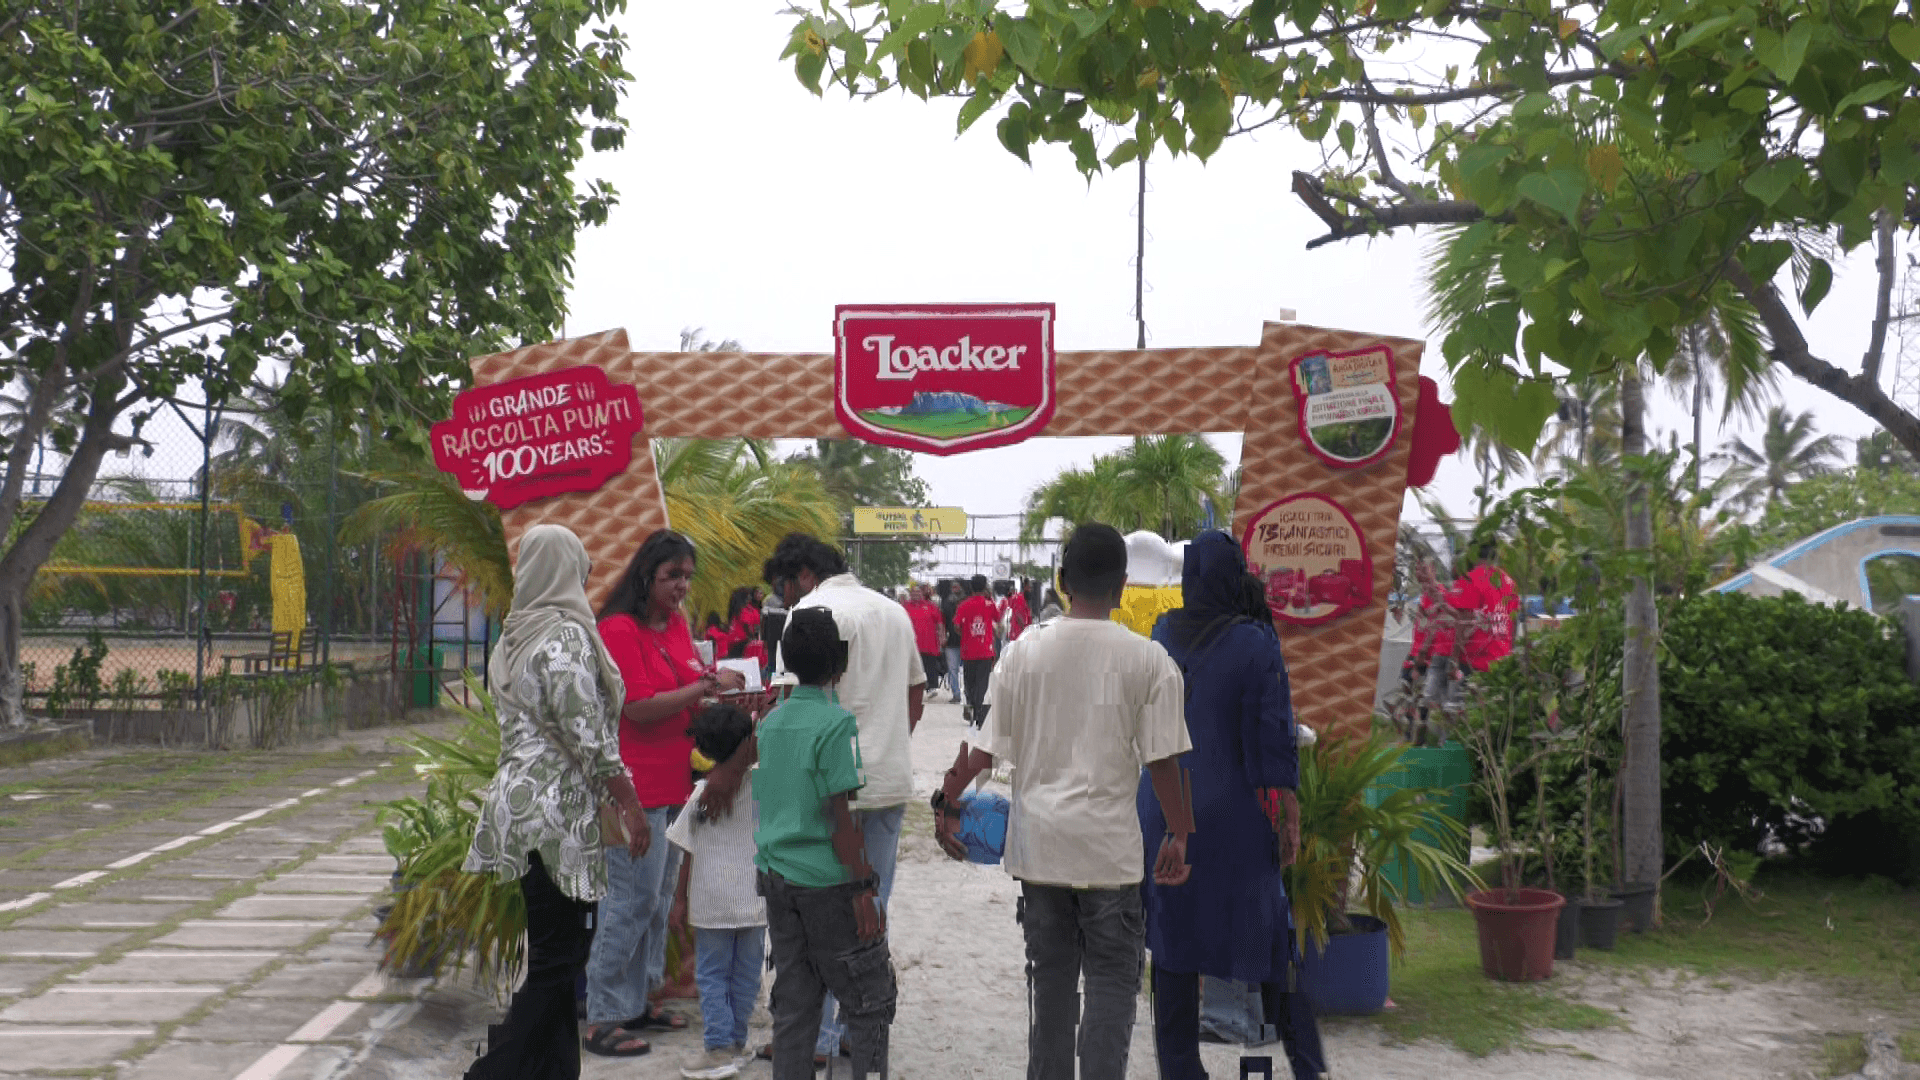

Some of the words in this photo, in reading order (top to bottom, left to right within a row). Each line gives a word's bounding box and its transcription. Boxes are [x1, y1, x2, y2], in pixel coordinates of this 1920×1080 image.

[862, 334, 1028, 381] Loacker
[488, 384, 571, 418] GRANDE
[441, 412, 560, 458] RACCOLTA
[562, 397, 633, 431] PUNTI
[482, 445, 536, 483] 100
[536, 434, 604, 466] YEARS
